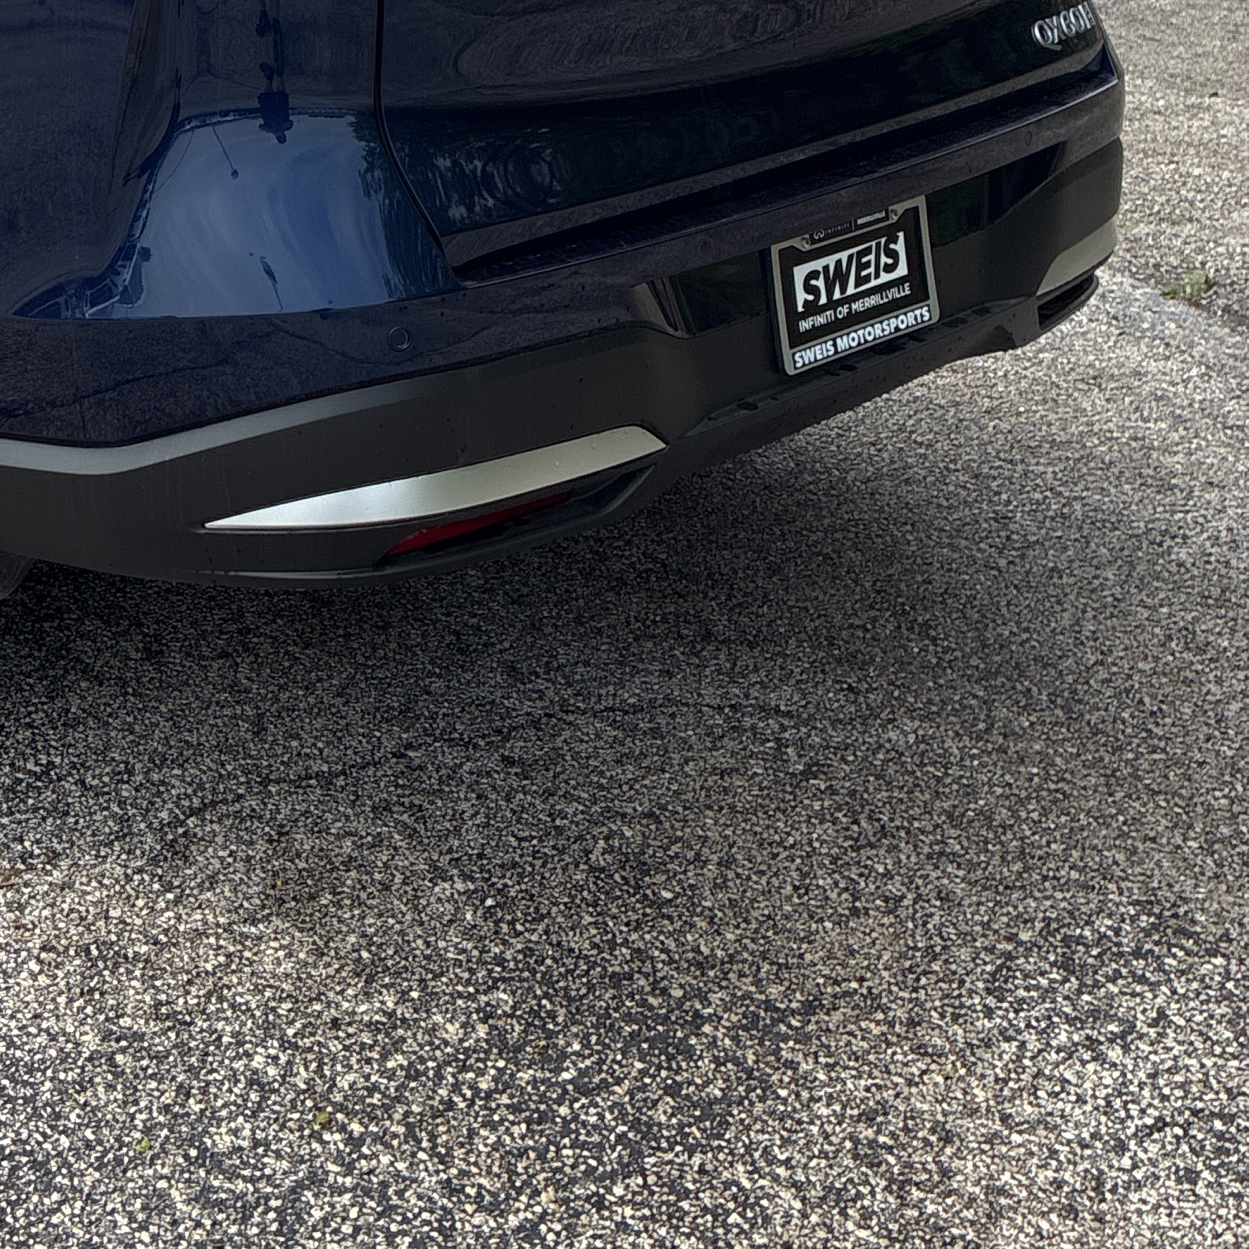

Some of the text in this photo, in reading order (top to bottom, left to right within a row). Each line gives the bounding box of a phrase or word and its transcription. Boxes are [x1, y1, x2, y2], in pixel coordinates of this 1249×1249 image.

[799, 231, 904, 312] SWEIS
[794, 306, 931, 368] SWEIS MOTORSPORTS
[798, 282, 912, 333] INFINITI OF MERRILLVILLE
